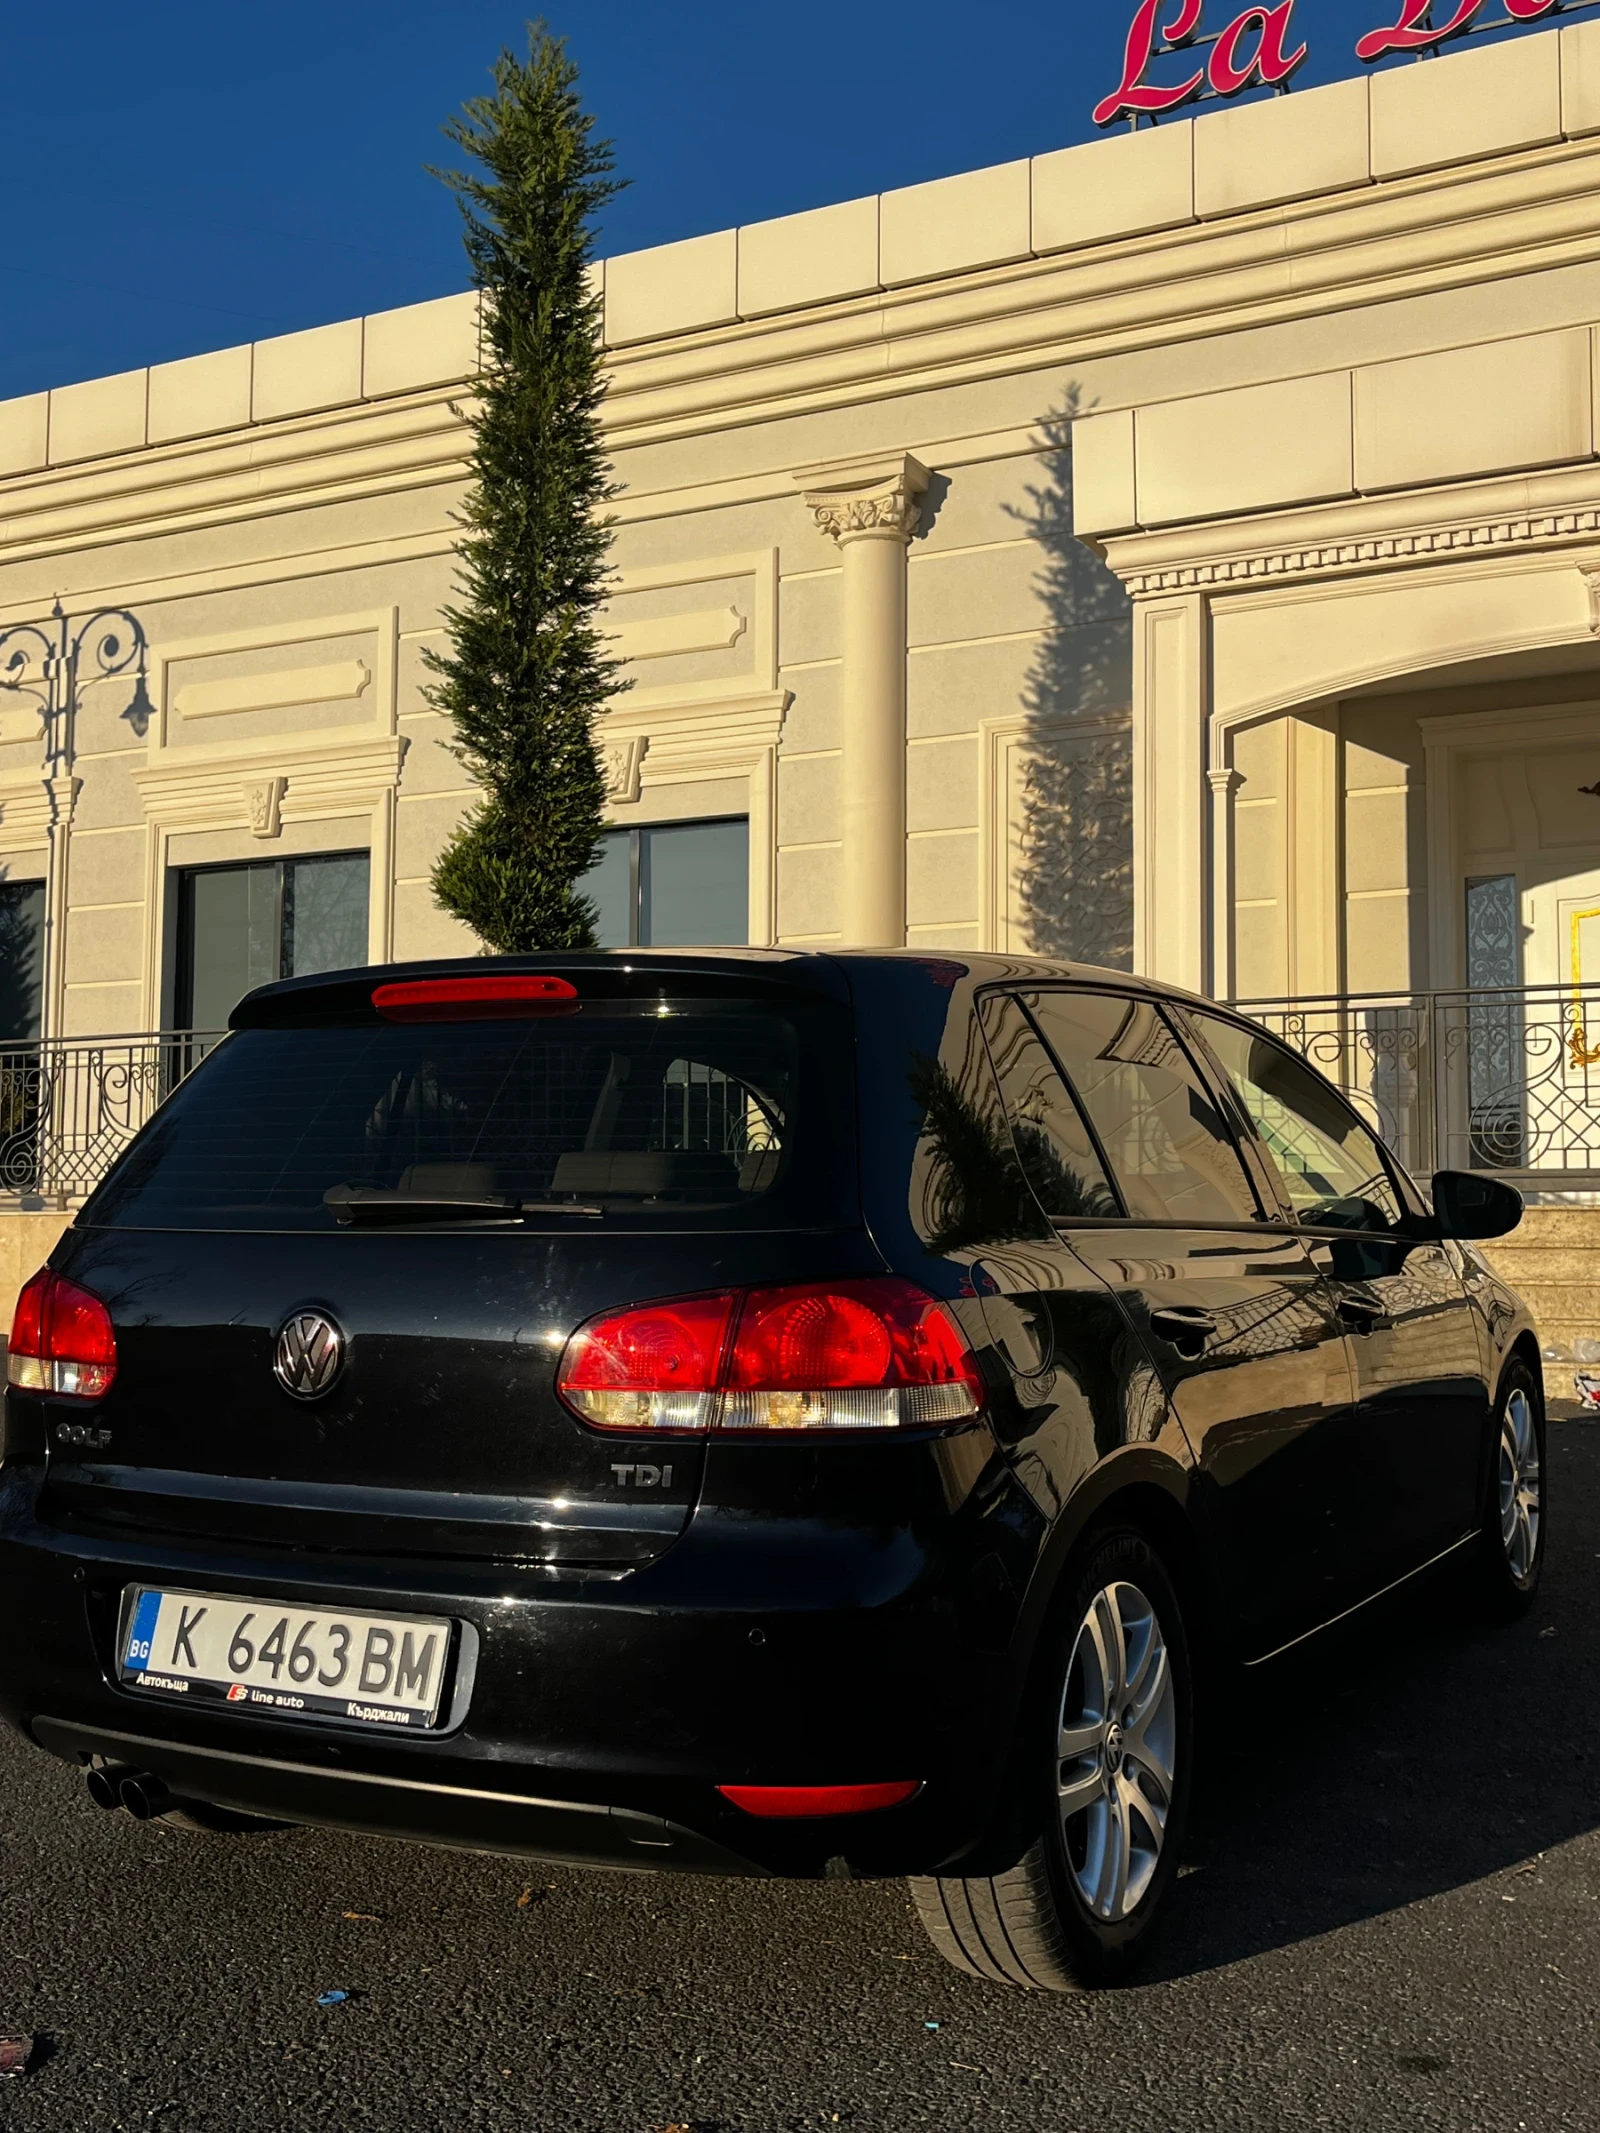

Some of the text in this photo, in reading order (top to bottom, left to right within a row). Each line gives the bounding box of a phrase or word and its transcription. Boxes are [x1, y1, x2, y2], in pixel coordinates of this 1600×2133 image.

[1092, 0, 1307, 125] La
[56, 1422, 112, 1449] GOLF
[611, 1464, 673, 1488] TDI
[171, 1605, 208, 1669] K
[129, 1639, 149, 1659] BG
[136, 1672, 189, 1692] Автокъща
[251, 1690, 274, 1704] line
[275, 1695, 305, 1709] auto
[347, 1702, 410, 1724] Кърджали
